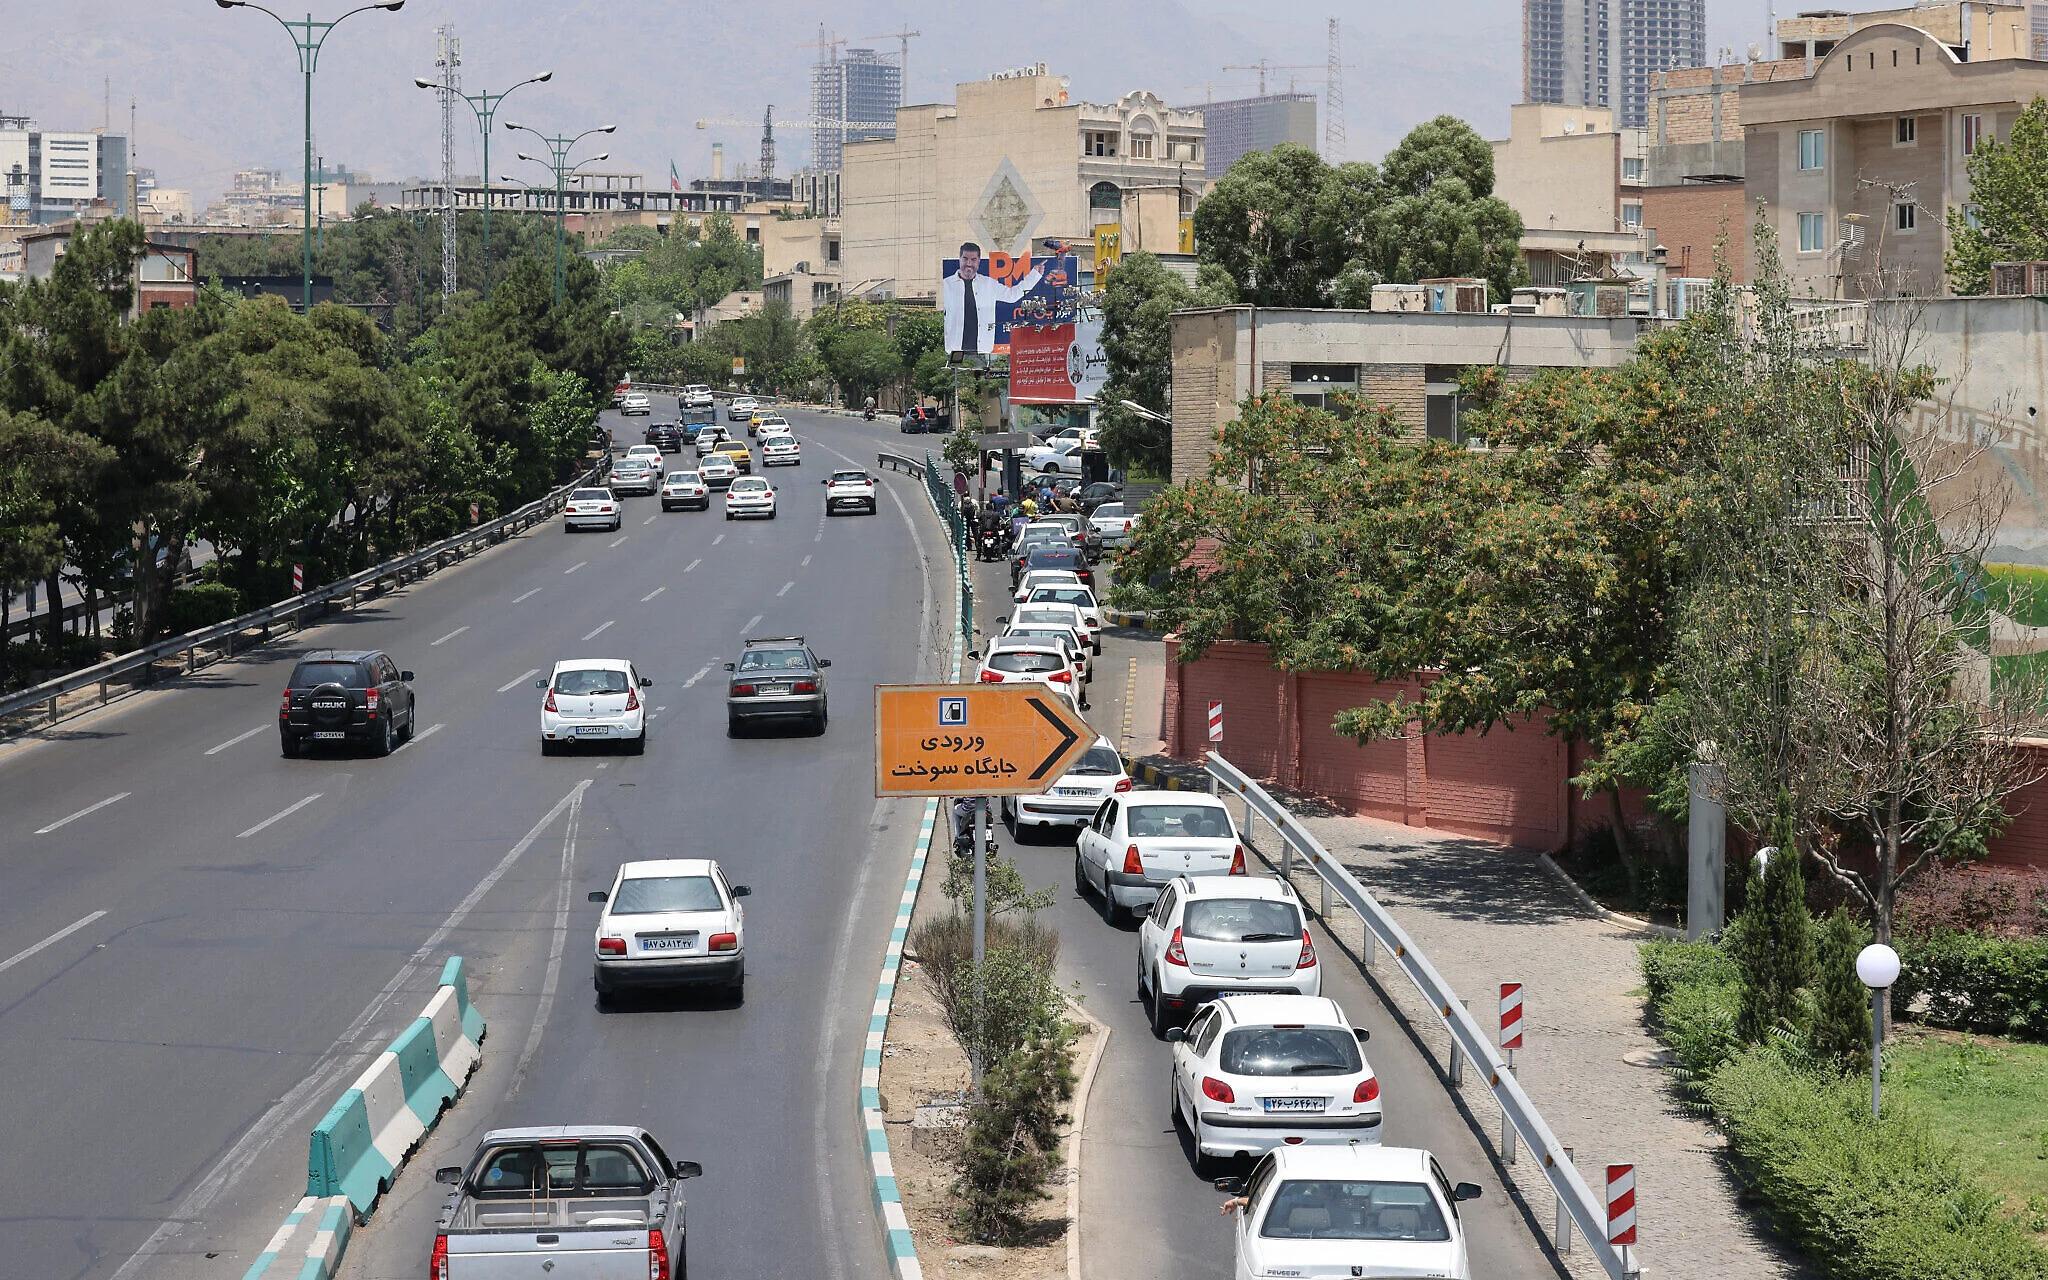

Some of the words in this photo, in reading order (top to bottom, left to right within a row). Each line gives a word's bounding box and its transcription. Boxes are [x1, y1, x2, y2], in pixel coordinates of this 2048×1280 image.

[921, 735, 985, 752] ورودی
[892, 761, 958, 782] سوخت
[964, 757, 1018, 778] جایگاه
